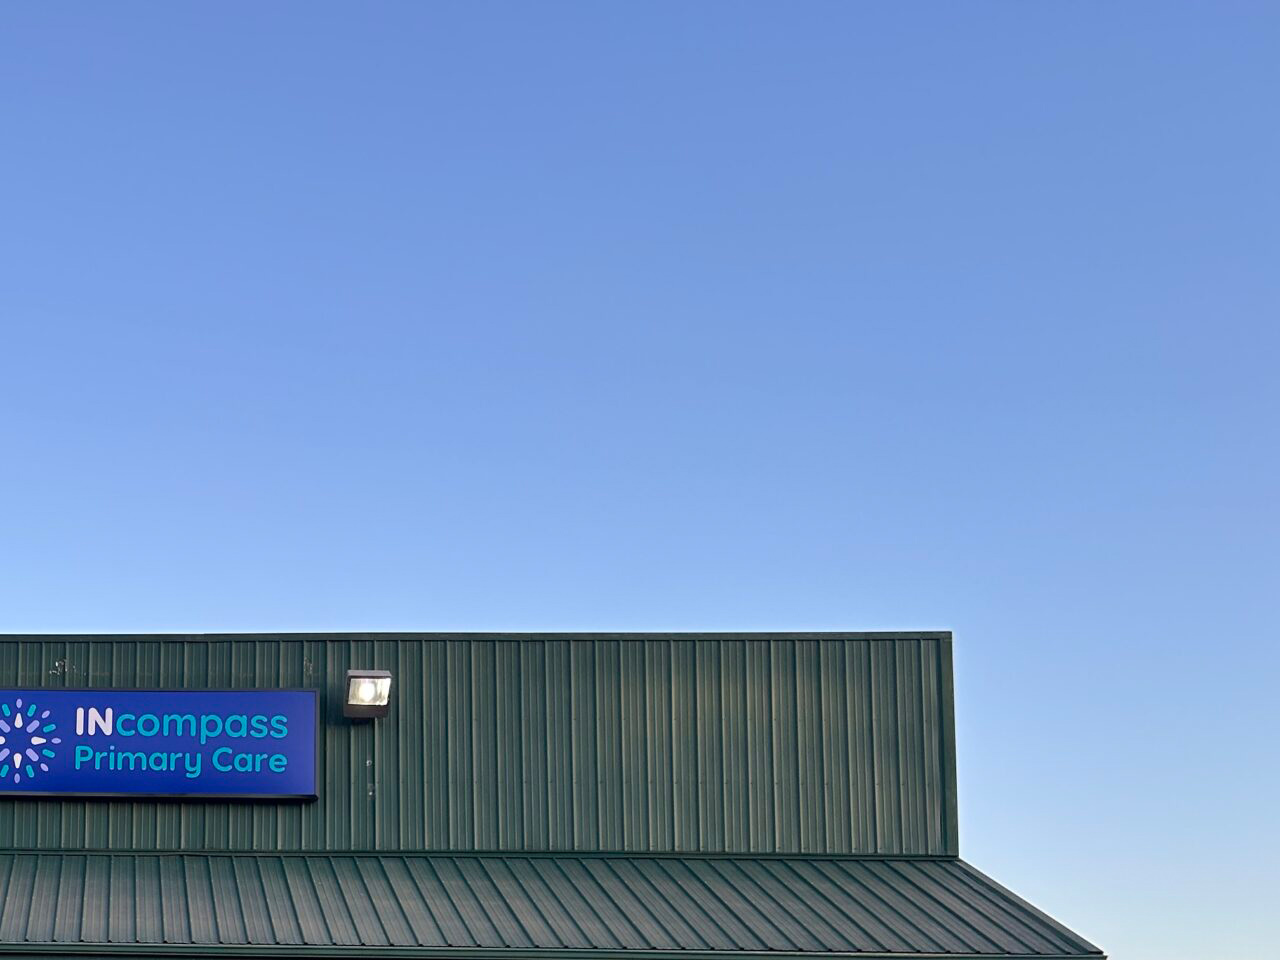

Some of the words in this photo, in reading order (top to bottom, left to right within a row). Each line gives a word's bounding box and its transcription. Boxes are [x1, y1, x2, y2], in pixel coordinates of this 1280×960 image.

[75, 707, 288, 744] INcompass
[75, 745, 202, 778] Primary
[212, 747, 288, 772] Care
